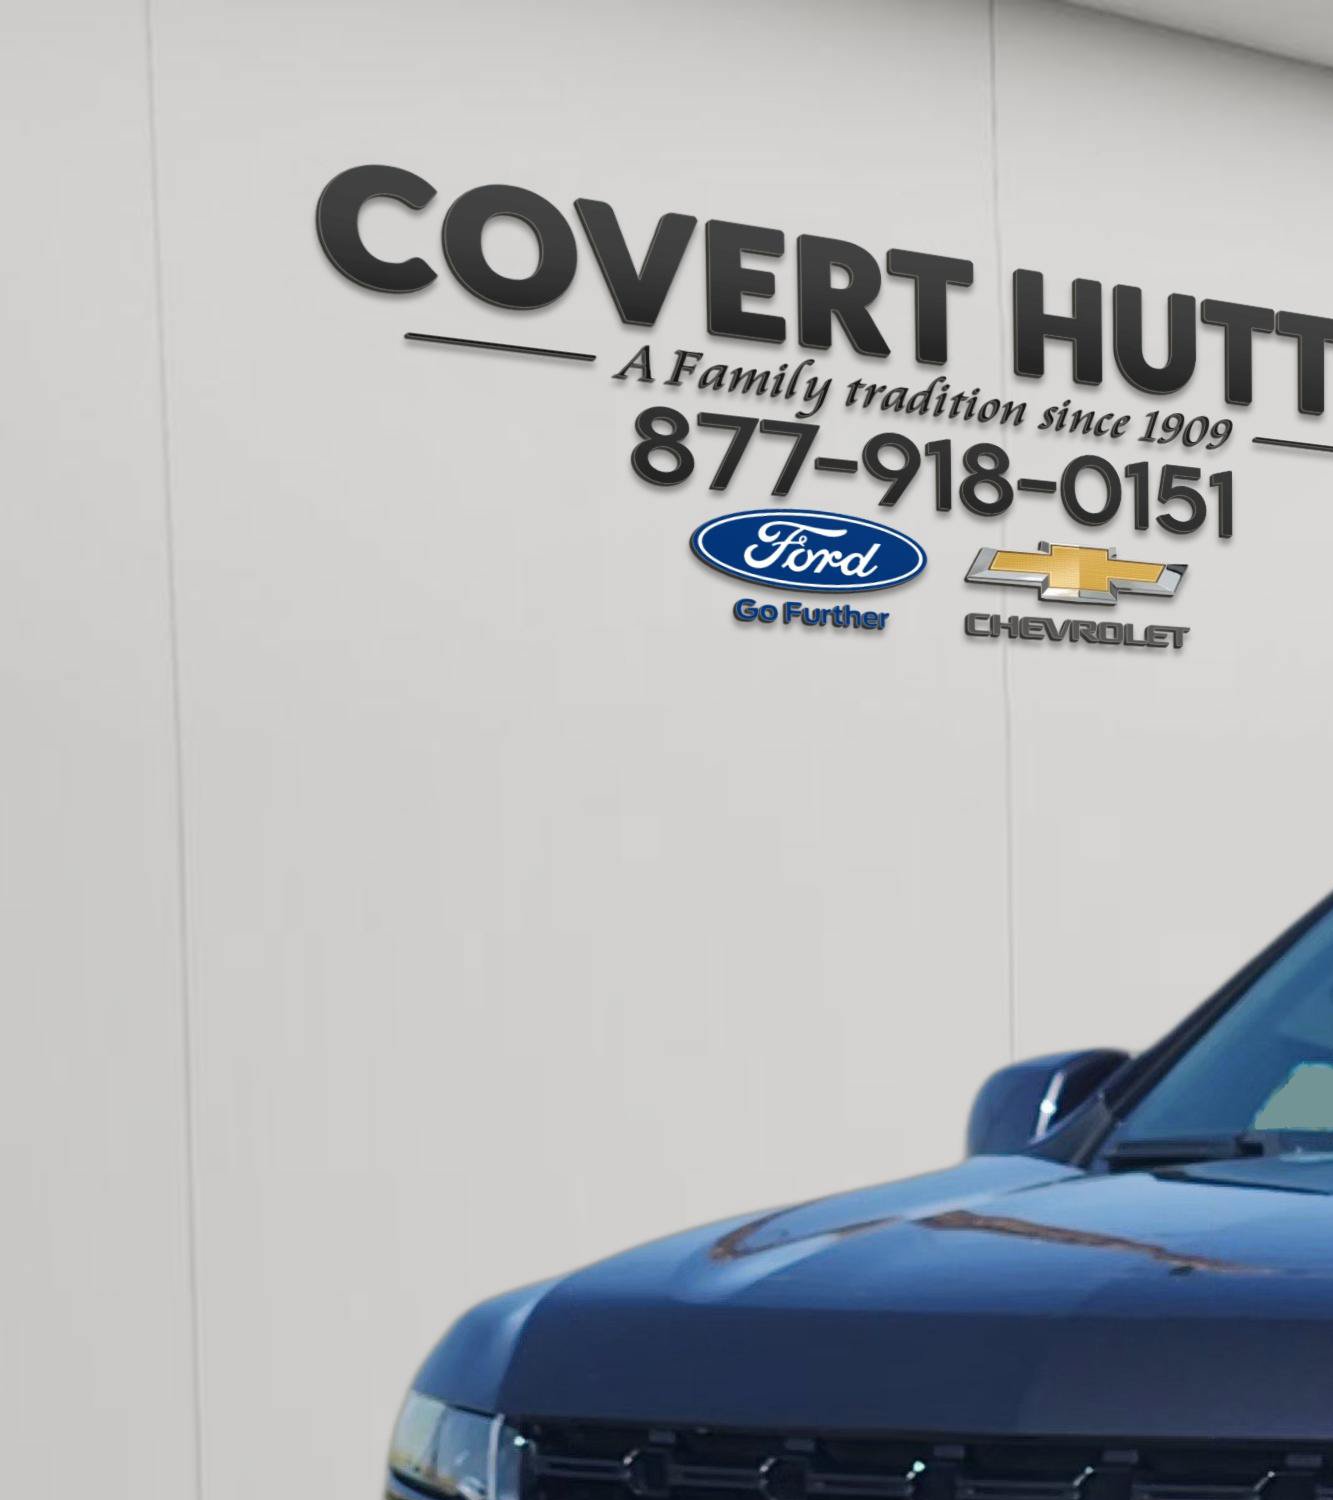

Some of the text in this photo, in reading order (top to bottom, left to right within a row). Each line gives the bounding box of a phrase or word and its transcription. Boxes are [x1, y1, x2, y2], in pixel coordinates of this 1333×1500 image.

[316, 164, 974, 365] COVERT
[611, 345, 1234, 450] A Family tradition since 1909
[630, 406, 1232, 539] 877-918-0151
[743, 520, 882, 578] Ford
[733, 598, 890, 631] Go Further
[964, 612, 1191, 650] CHEVROLET
